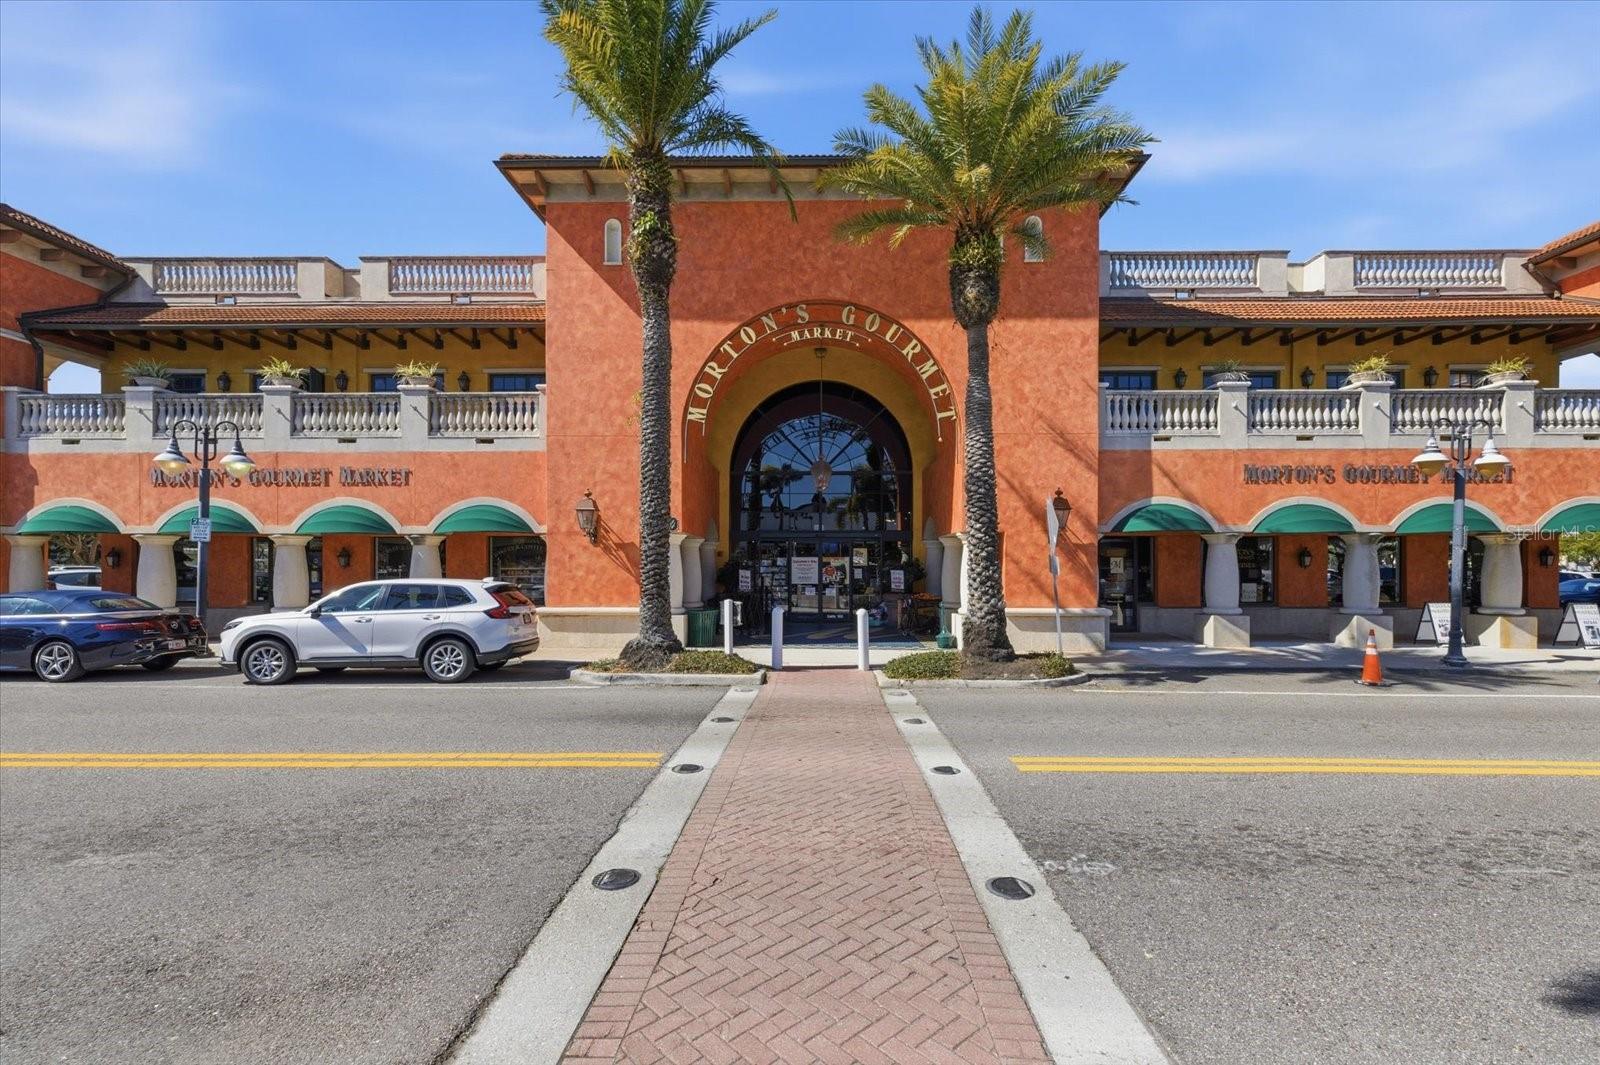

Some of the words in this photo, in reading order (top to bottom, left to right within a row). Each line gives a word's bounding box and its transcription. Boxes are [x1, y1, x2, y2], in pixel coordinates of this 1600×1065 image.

[791, 327, 854, 342] MARKET
[687, 304, 810, 424] MORTON'S
[842, 305, 957, 421] GOURMET
[149, 466, 241, 488] MORTN'S
[249, 466, 333, 487] GOURMET
[340, 466, 413, 487] MARKET
[1243, 463, 1336, 485] MORTON'S
